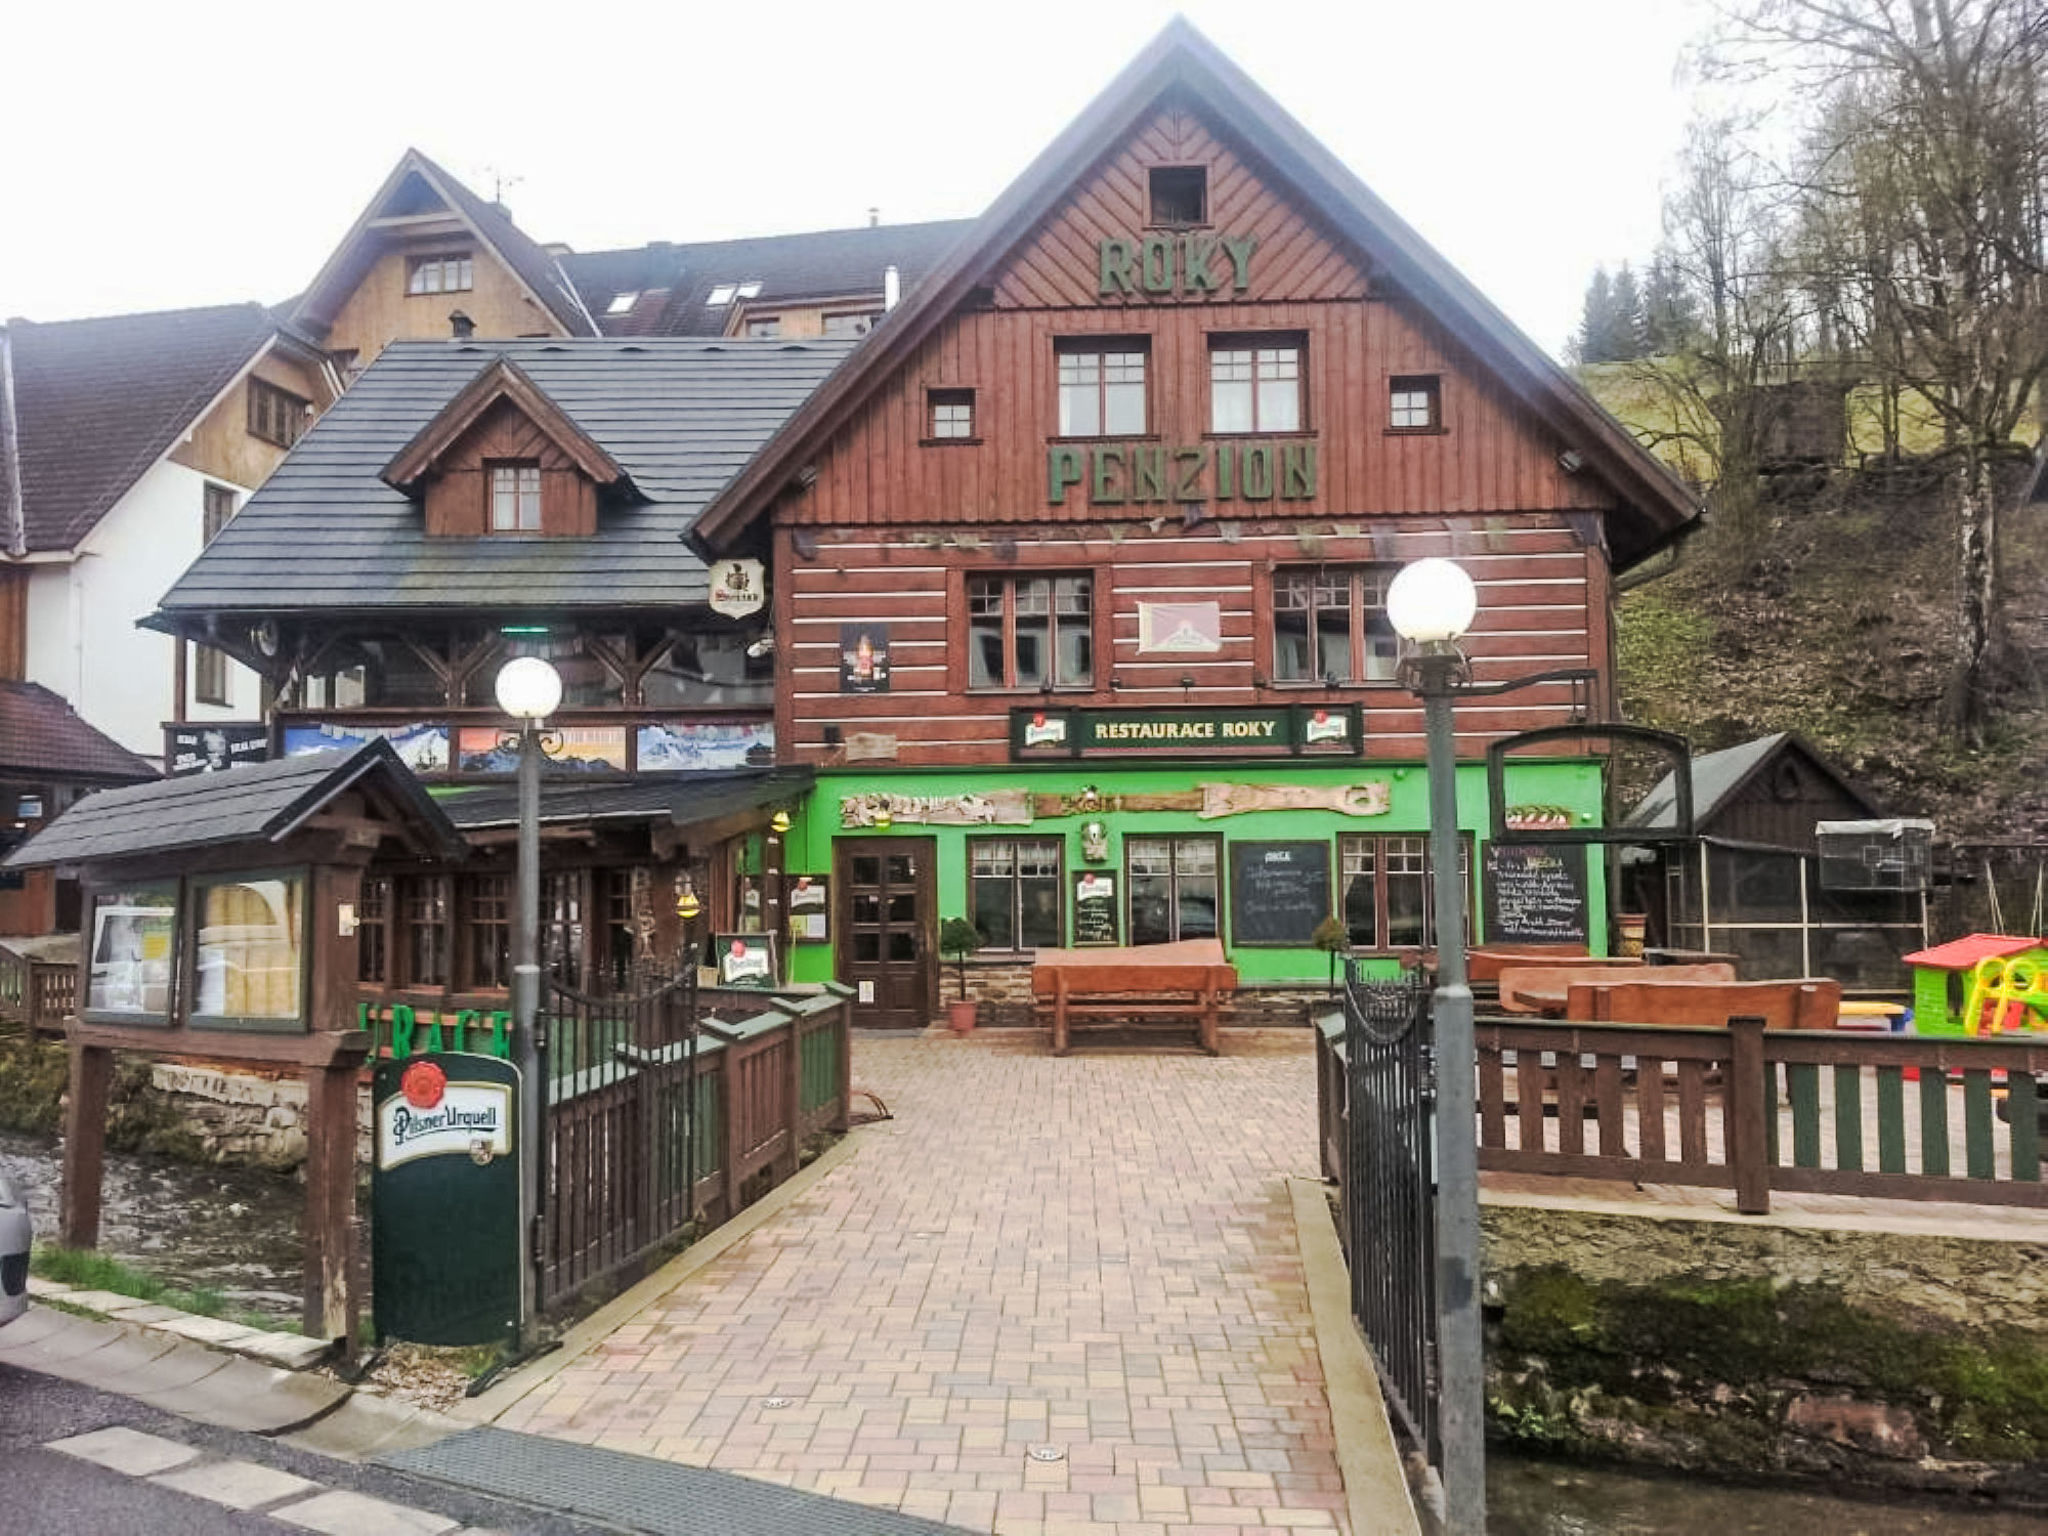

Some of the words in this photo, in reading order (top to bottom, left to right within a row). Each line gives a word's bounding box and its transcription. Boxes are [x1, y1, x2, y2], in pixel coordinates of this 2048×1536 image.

[1099, 234, 1257, 295] ROKY
[1048, 443, 1318, 505] PENZION
[1095, 722, 1215, 740] RESTAURACE
[1222, 720, 1277, 739] ROKY
[392, 1106, 446, 1146] Pilsner
[444, 1105, 497, 1134] Urquell
